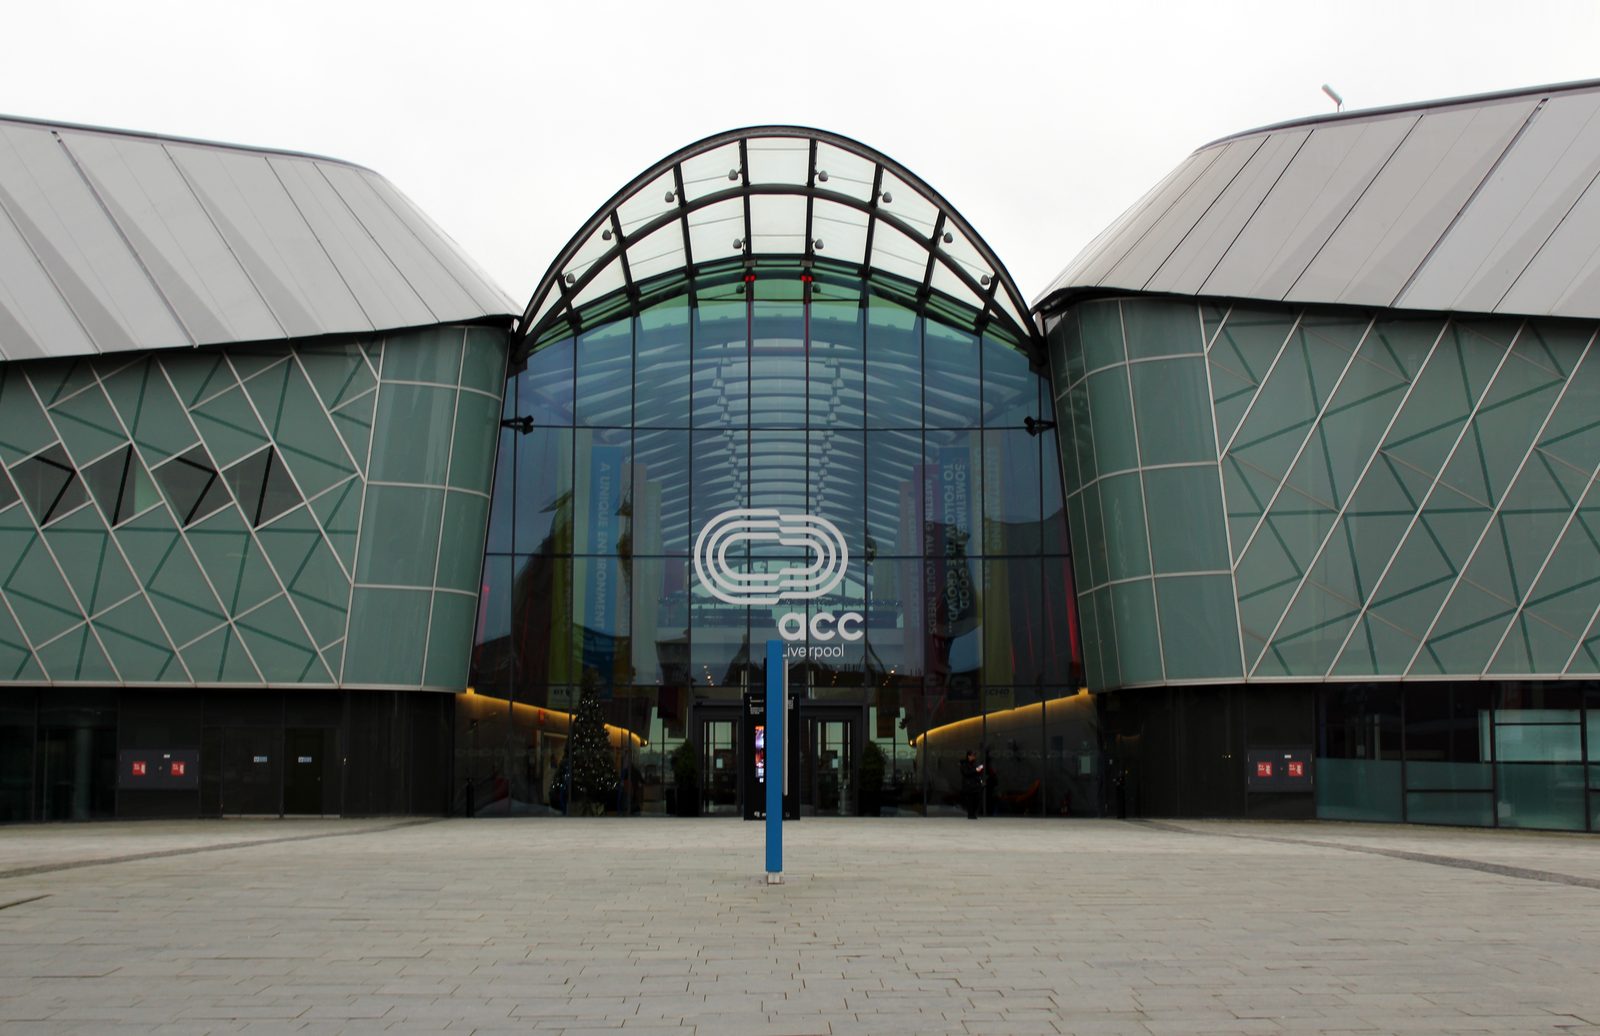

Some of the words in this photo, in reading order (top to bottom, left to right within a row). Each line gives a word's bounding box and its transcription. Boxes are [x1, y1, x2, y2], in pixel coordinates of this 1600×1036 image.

[599, 463, 610, 473] A
[943, 463, 954, 481] TO
[597, 476, 610, 527] UNIQUE
[943, 485, 957, 543] FOLLOW
[954, 463, 968, 536] SOMETIMES
[926, 534, 936, 555] ALL
[593, 531, 608, 630] ENVIRONMENT
[957, 567, 970, 610] GOOD
[778, 612, 864, 641] acc
[927, 596, 938, 635] NEEDS
